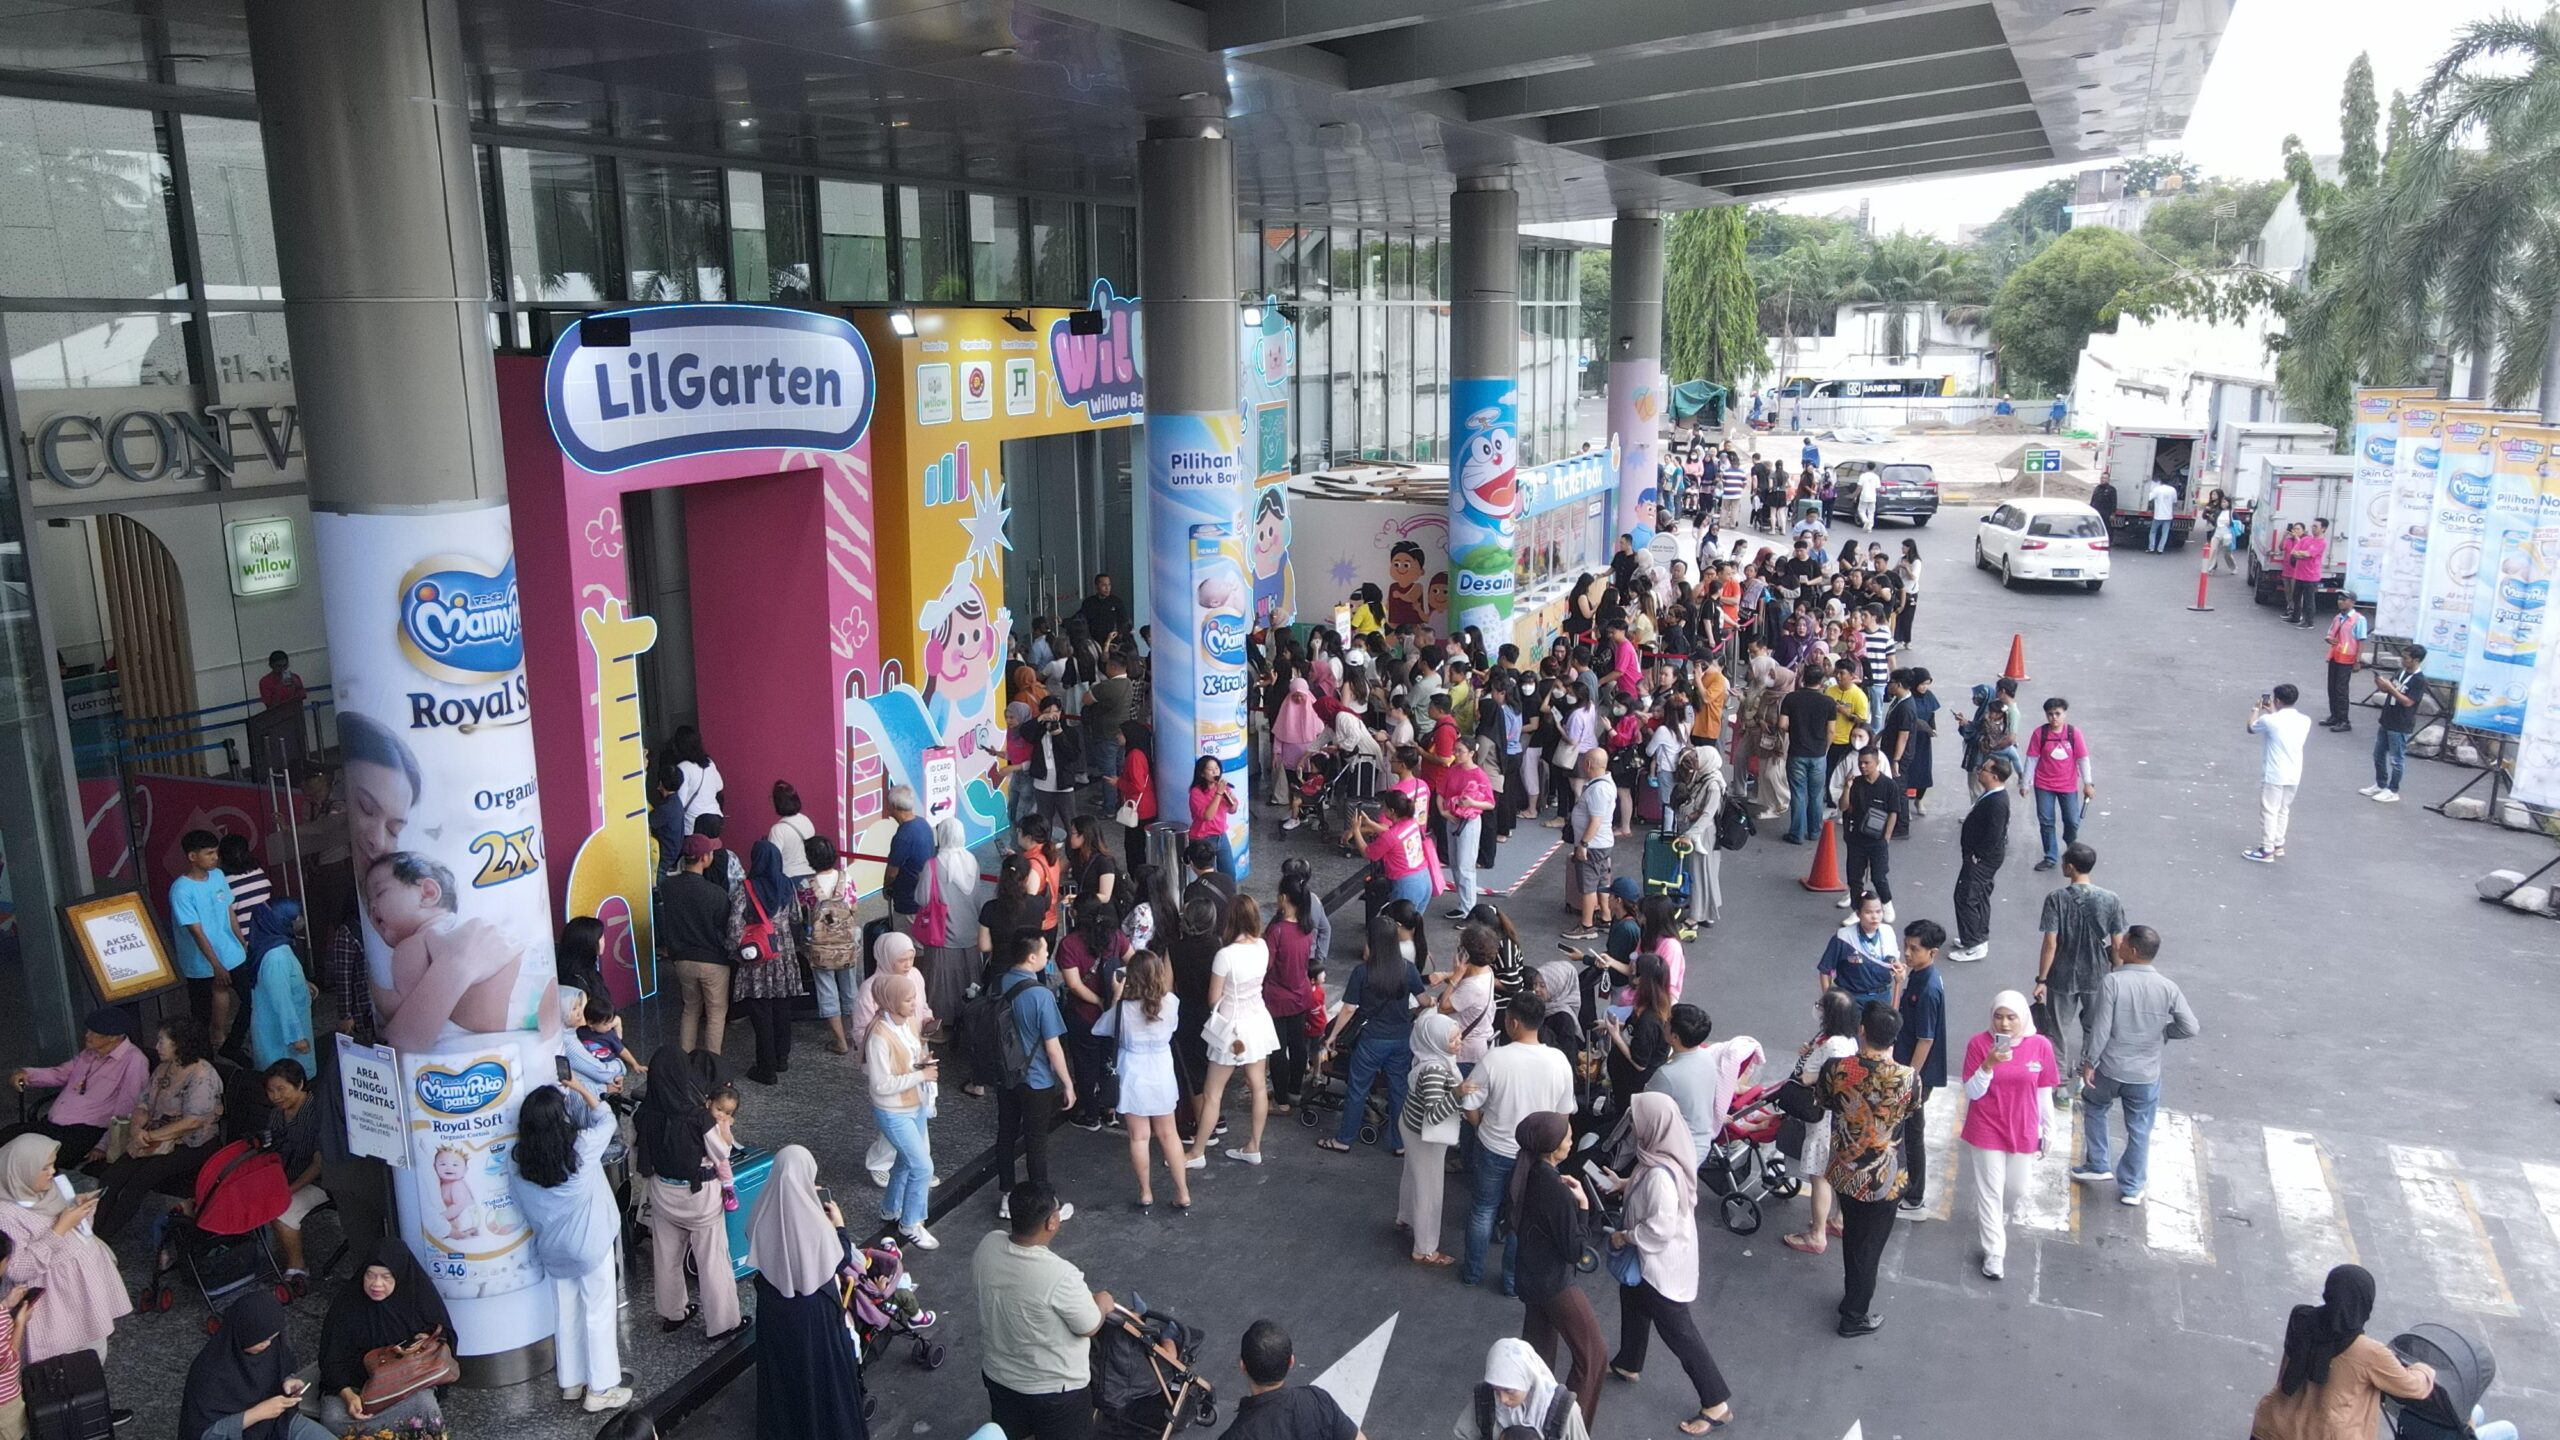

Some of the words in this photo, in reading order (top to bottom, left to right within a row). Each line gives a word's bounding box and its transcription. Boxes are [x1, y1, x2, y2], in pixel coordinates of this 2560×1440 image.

[1056, 308, 1143, 394] Wil
[595, 352, 842, 421] LilGarten
[1862, 384, 1886, 393] BANK
[1887, 384, 1901, 393] BRI
[1091, 394, 1128, 414] Willow
[1172, 453, 1232, 470] Pilihan
[1172, 472, 1212, 485] untuk
[2361, 470, 2381, 478] Skin
[1553, 470, 1586, 501] TICKET
[1586, 465, 1603, 490] BOX
[2497, 493, 2535, 505] Pilihan
[2441, 511, 2465, 523] Skin
[243, 557, 291, 576] willow
[1460, 574, 1513, 591] Desain
[1204, 676, 1239, 695] X-tra
[407, 682, 513, 728] Royal
[937, 762, 951, 771] CARD
[932, 785, 950, 795] STAMP
[469, 825, 539, 889] 2X
[103, 946, 117, 957] KE
[120, 940, 146, 953] MALL
[106, 933, 137, 947] AKSES
[356, 1066, 379, 1080] AREA
[351, 1077, 388, 1095] TUNGGU
[420, 1073, 503, 1101] MamyPoko
[348, 1088, 396, 1110] PRIORITAS
[444, 1096, 480, 1110] pants
[432, 1118, 471, 1134] Royal
[474, 1113, 503, 1130] Soft
[433, 1261, 441, 1273] S
[447, 1263, 466, 1277] 46
